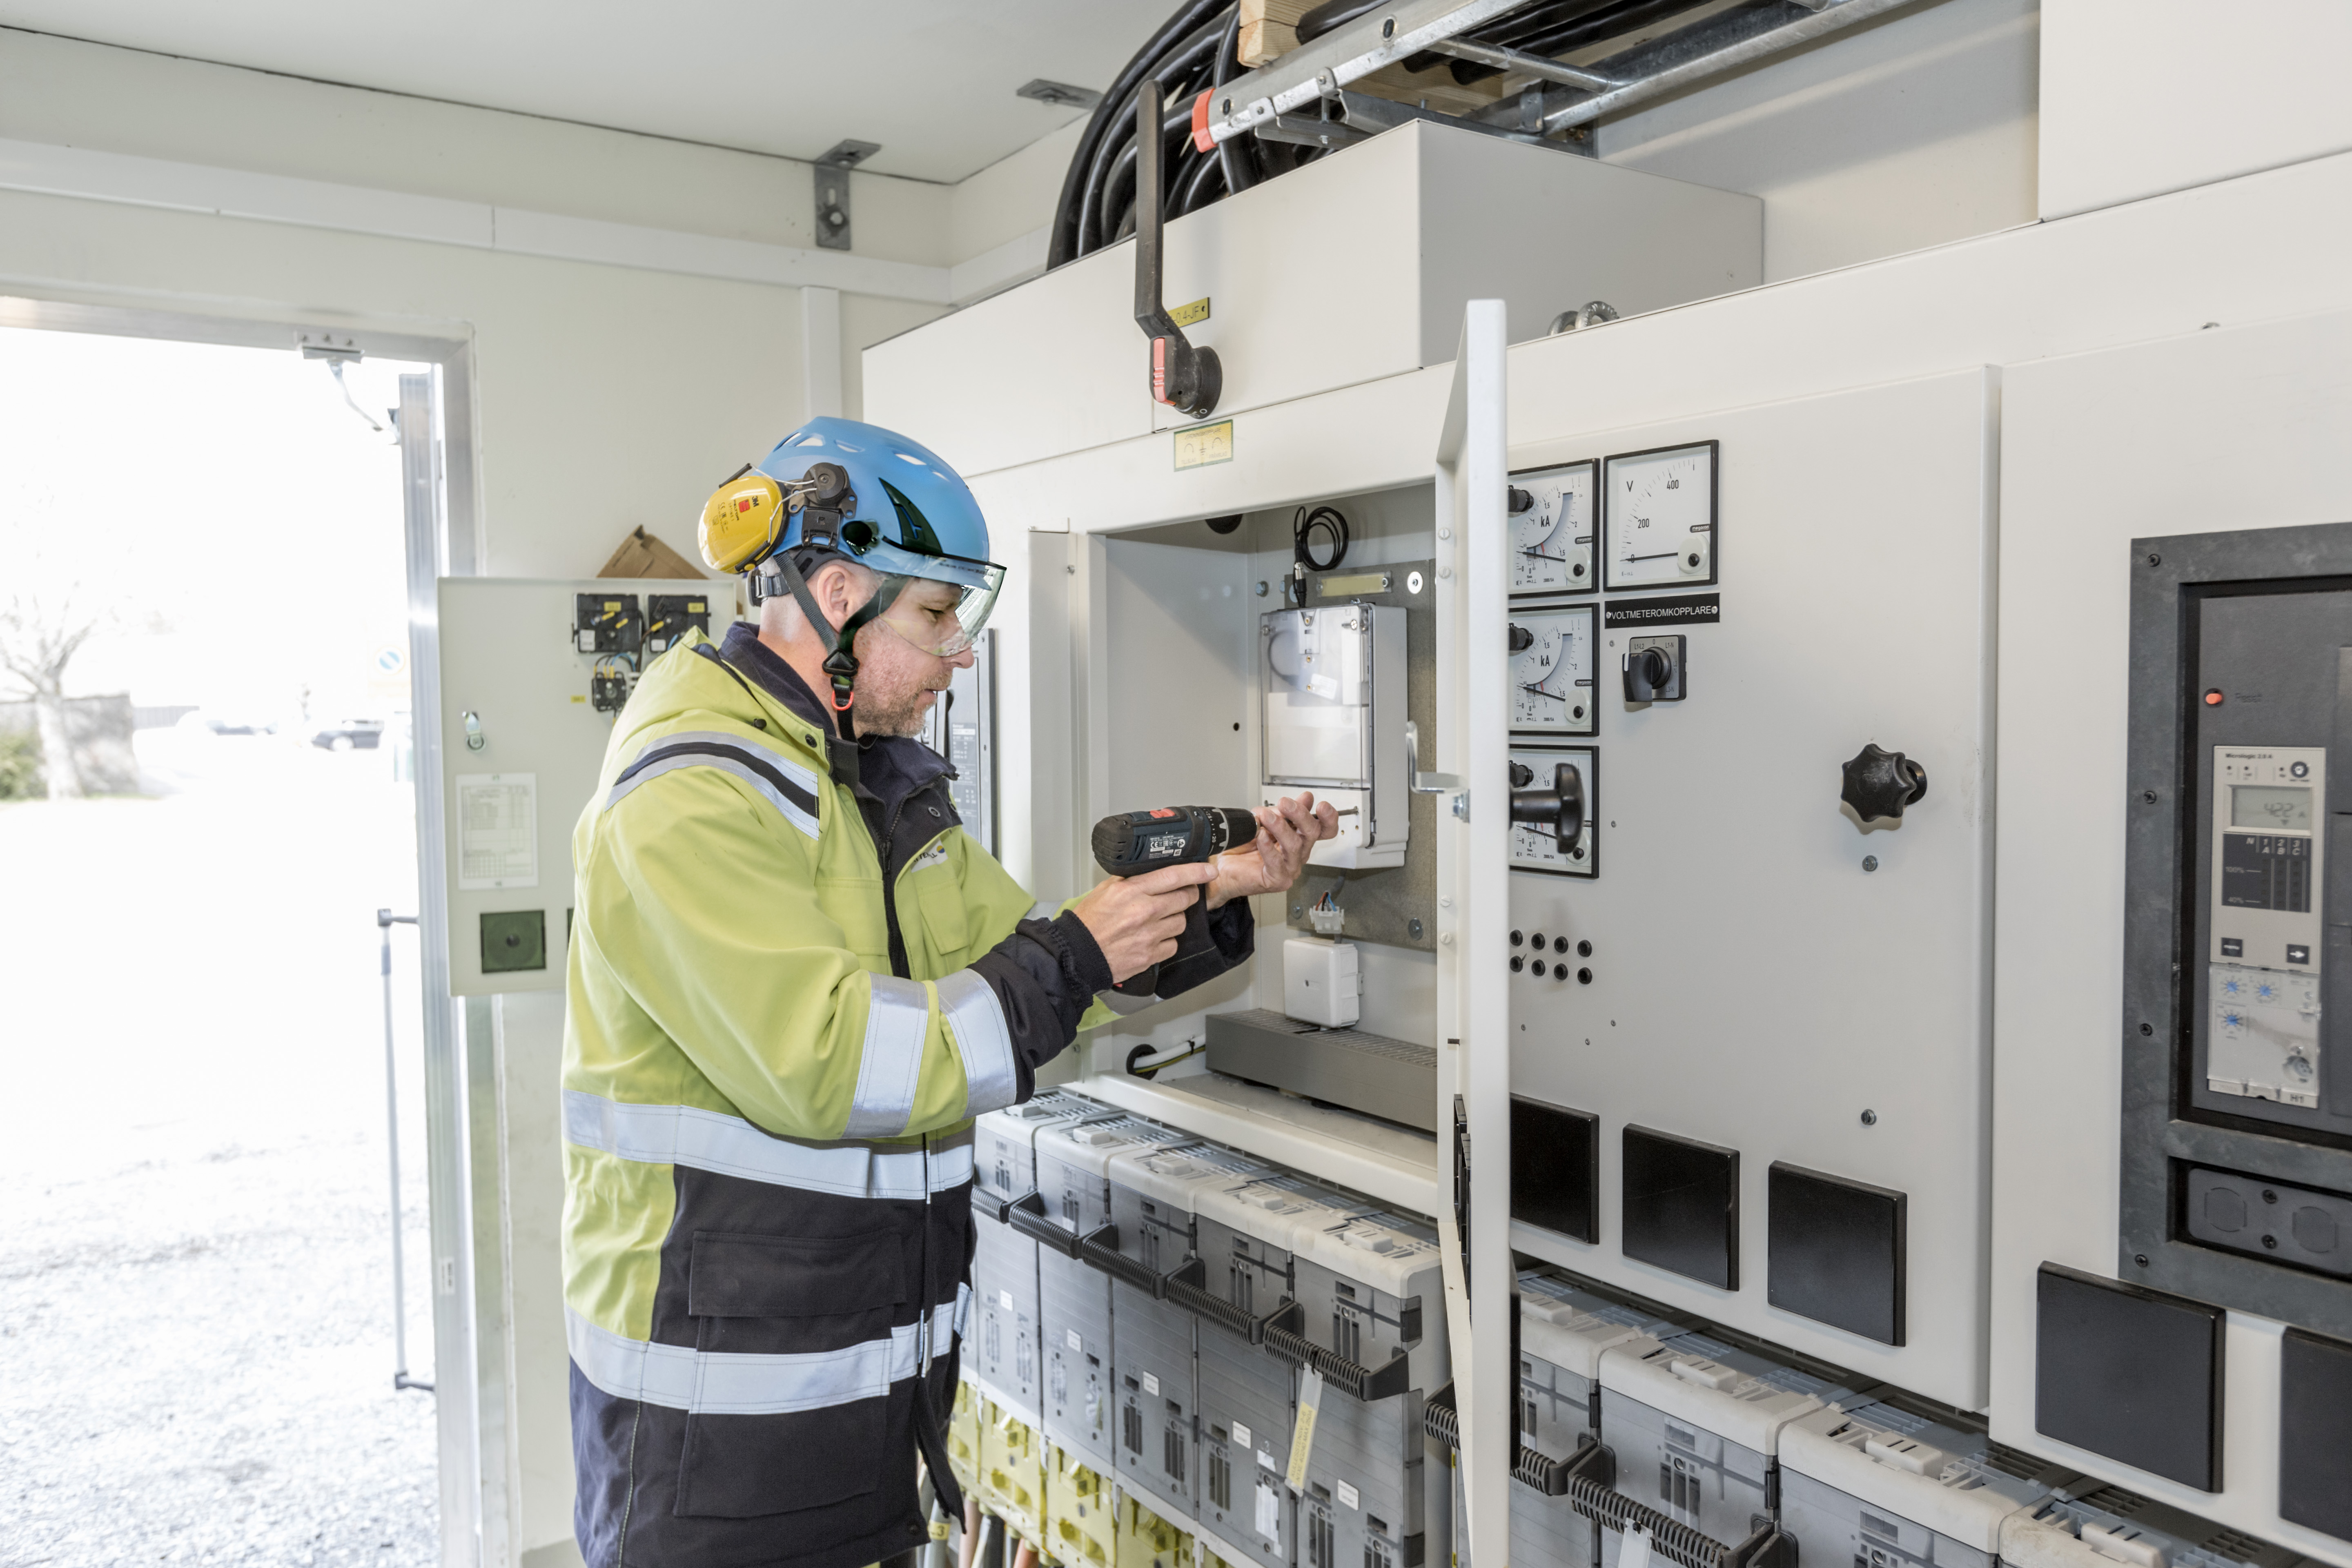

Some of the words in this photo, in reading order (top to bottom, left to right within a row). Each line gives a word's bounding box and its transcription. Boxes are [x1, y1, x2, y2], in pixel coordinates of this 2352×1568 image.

[1626, 480, 1633, 492] V
[1666, 479, 1679, 490] 400
[752, 496, 759, 507] 3M
[1541, 515, 1550, 527] kA
[1637, 519, 1650, 528] 200
[1630, 554, 1635, 563] 0
[1611, 606, 1711, 619] VOLTMETEROMKOPPLARE
[1541, 655, 1550, 666] kA
